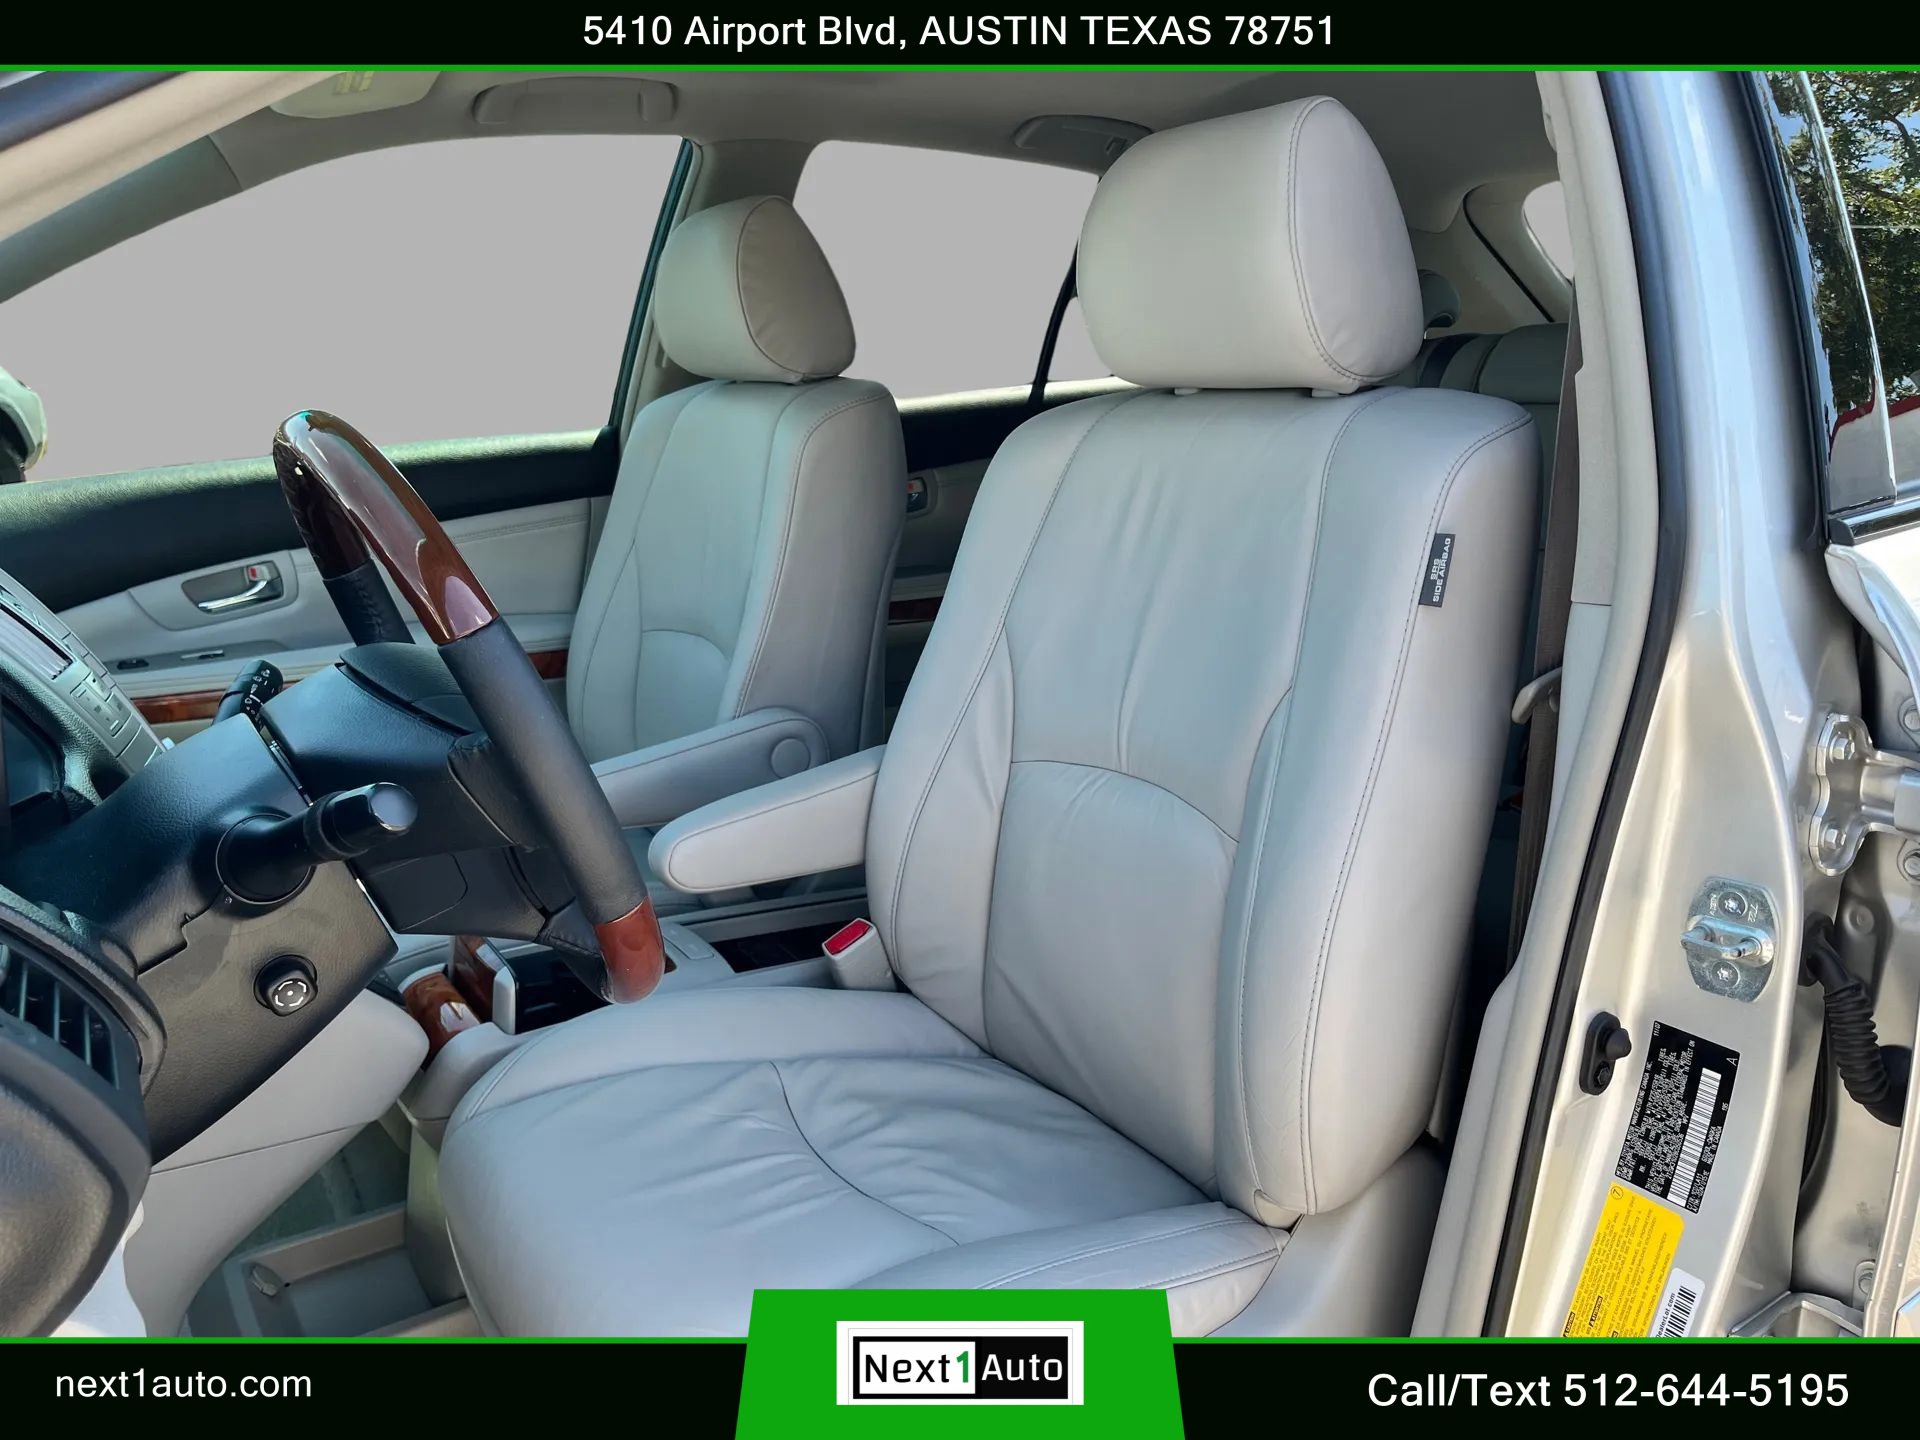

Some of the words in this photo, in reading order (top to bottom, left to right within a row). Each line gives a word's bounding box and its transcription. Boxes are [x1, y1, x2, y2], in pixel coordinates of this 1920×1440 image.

[1433, 578, 1443, 602] SIDE
[1438, 537, 1451, 578] AIRBAG
[1725, 1054, 1738, 1066] A
